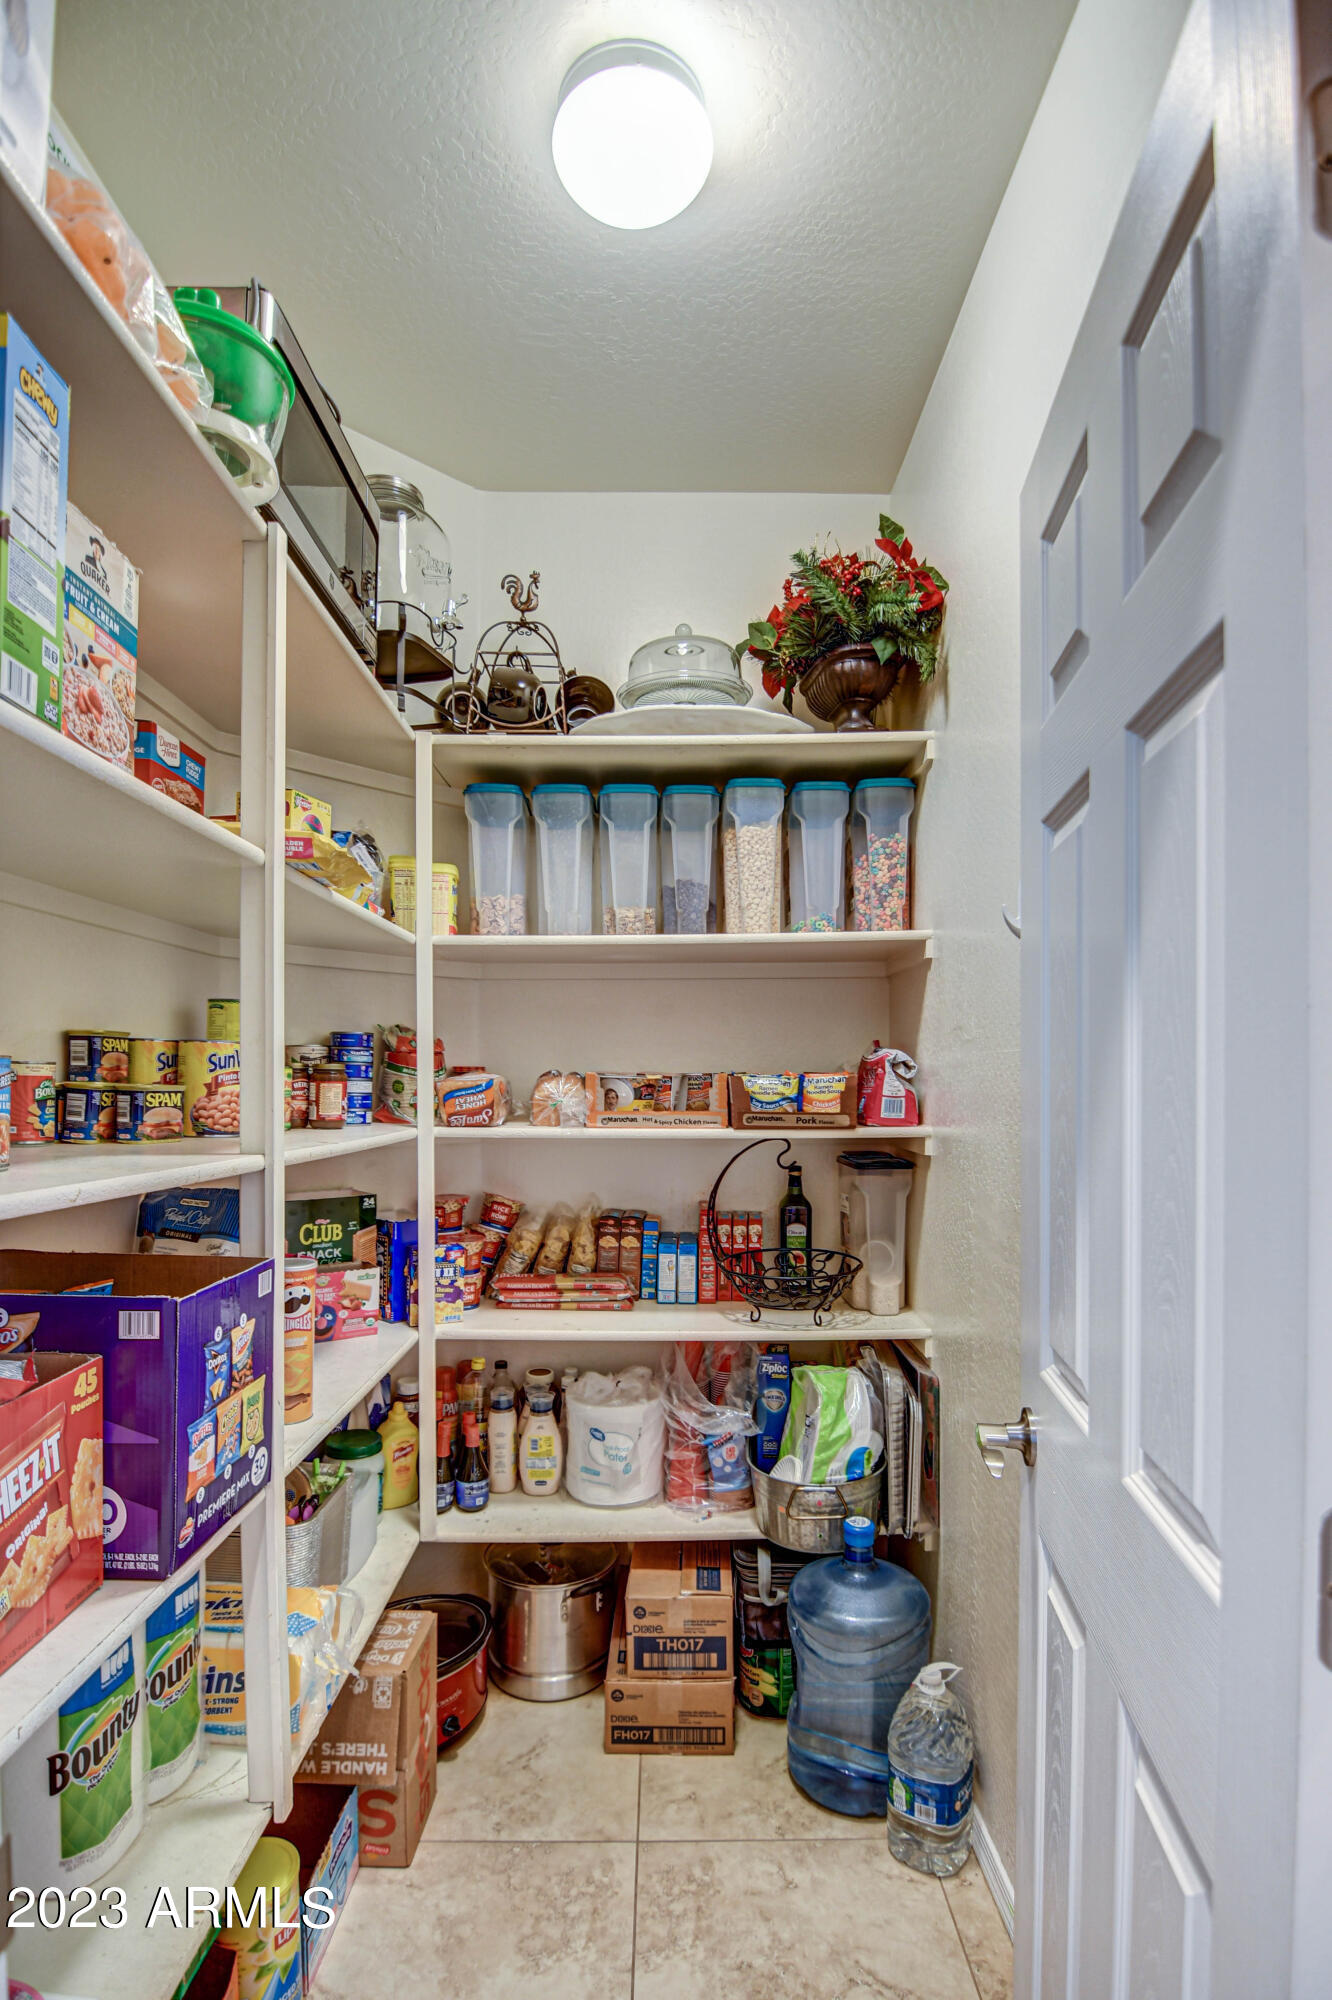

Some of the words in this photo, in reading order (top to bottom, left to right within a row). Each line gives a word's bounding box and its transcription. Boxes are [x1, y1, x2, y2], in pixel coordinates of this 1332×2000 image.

[19, 366, 58, 428] CHEWY
[80, 561, 111, 595] QUAKER
[65, 580, 90, 607] FRUIT
[90, 603, 95, 613] &
[97, 608, 120, 636] CREAM
[102, 1038, 128, 1053] SPAM
[218, 1074, 237, 1084] Pinto
[145, 1093, 182, 1107] SPAM
[455, 1093, 486, 1104] WHEAT
[455, 1098, 487, 1110] HONEY
[448, 1115, 466, 1127] Lee
[466, 1108, 492, 1125] Sara
[796, 1116, 817, 1124] Pork
[493, 1204, 509, 1213] RICE
[165, 1230, 192, 1240] ORIGINAL
[299, 1223, 343, 1246] CLUB
[208, 1352, 227, 1370] Doritos
[761, 1363, 787, 1374] Ziploc
[74, 1366, 98, 1398] 45
[71, 1392, 99, 1415] Pouches
[254, 1453, 266, 1475] 30
[197, 1484, 236, 1527] PREMIERE
[236, 1470, 251, 1492] MIX
[145, 1629, 201, 1704] ounty
[213, 1697, 239, 1705] STRONG
[46, 1688, 140, 1797] Bounty
[321, 1742, 388, 1757] THERE'S
[320, 1760, 388, 1776] HANDLE
